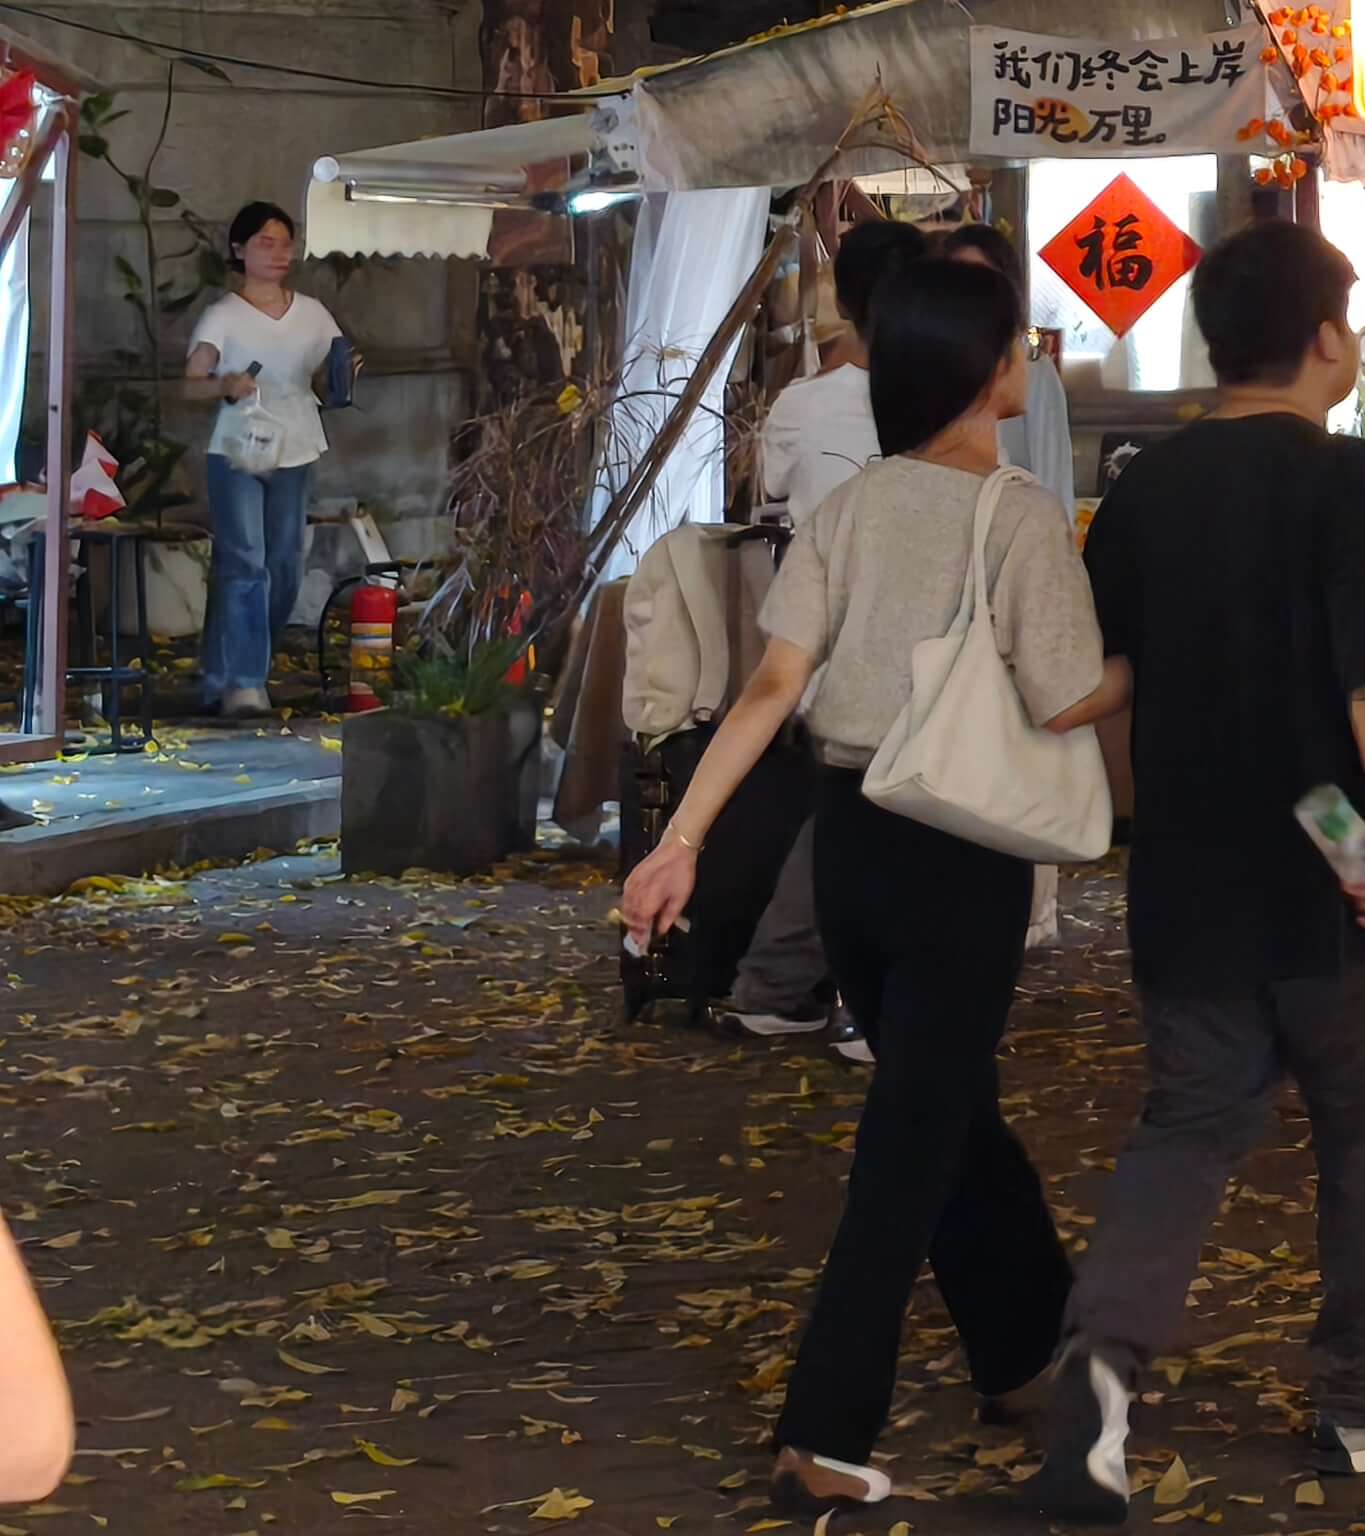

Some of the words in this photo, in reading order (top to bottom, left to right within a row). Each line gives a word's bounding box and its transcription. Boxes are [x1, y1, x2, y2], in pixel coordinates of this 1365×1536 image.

[992, 40, 1247, 90] 我们终会上岸
[1073, 213, 1153, 291] 福
